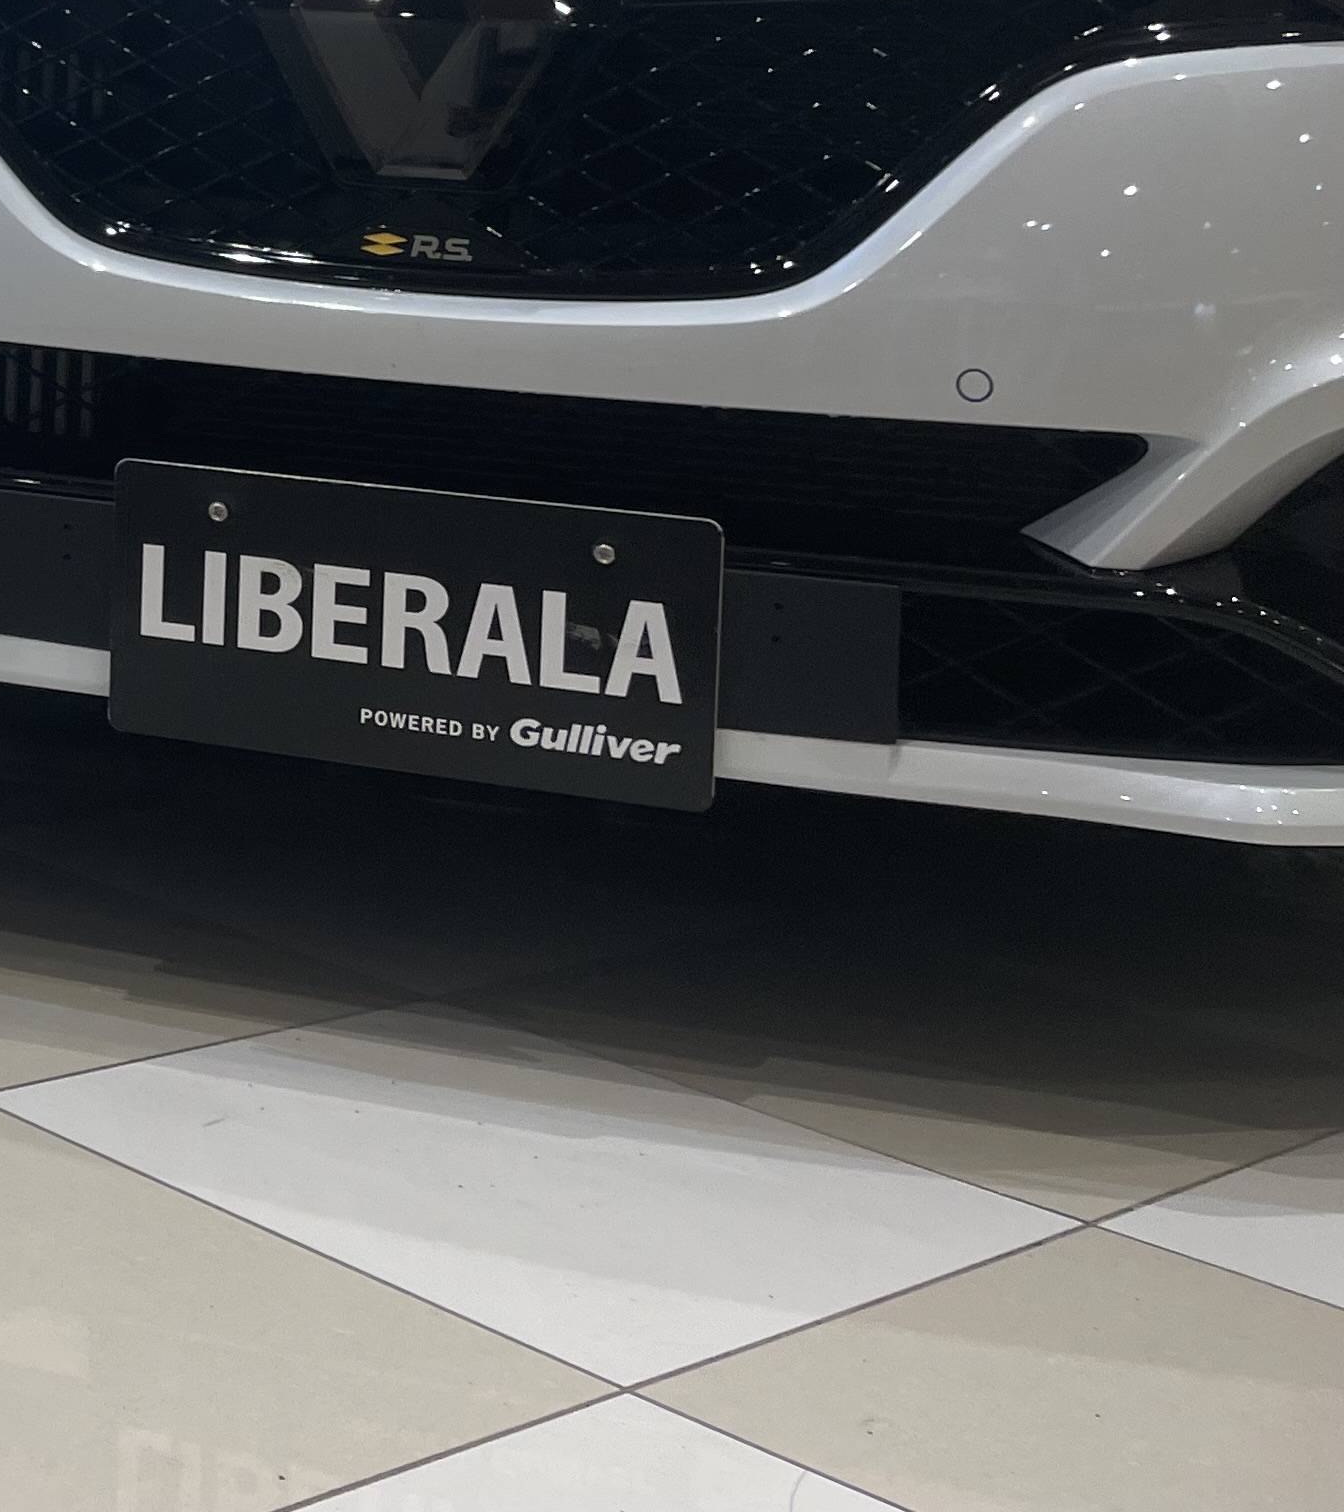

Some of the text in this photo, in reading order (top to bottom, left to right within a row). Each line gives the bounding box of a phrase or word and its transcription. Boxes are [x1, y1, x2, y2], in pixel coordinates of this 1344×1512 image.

[139, 543, 684, 705] LIBERALA
[360, 708, 682, 765] POWERED BY Gulliver
